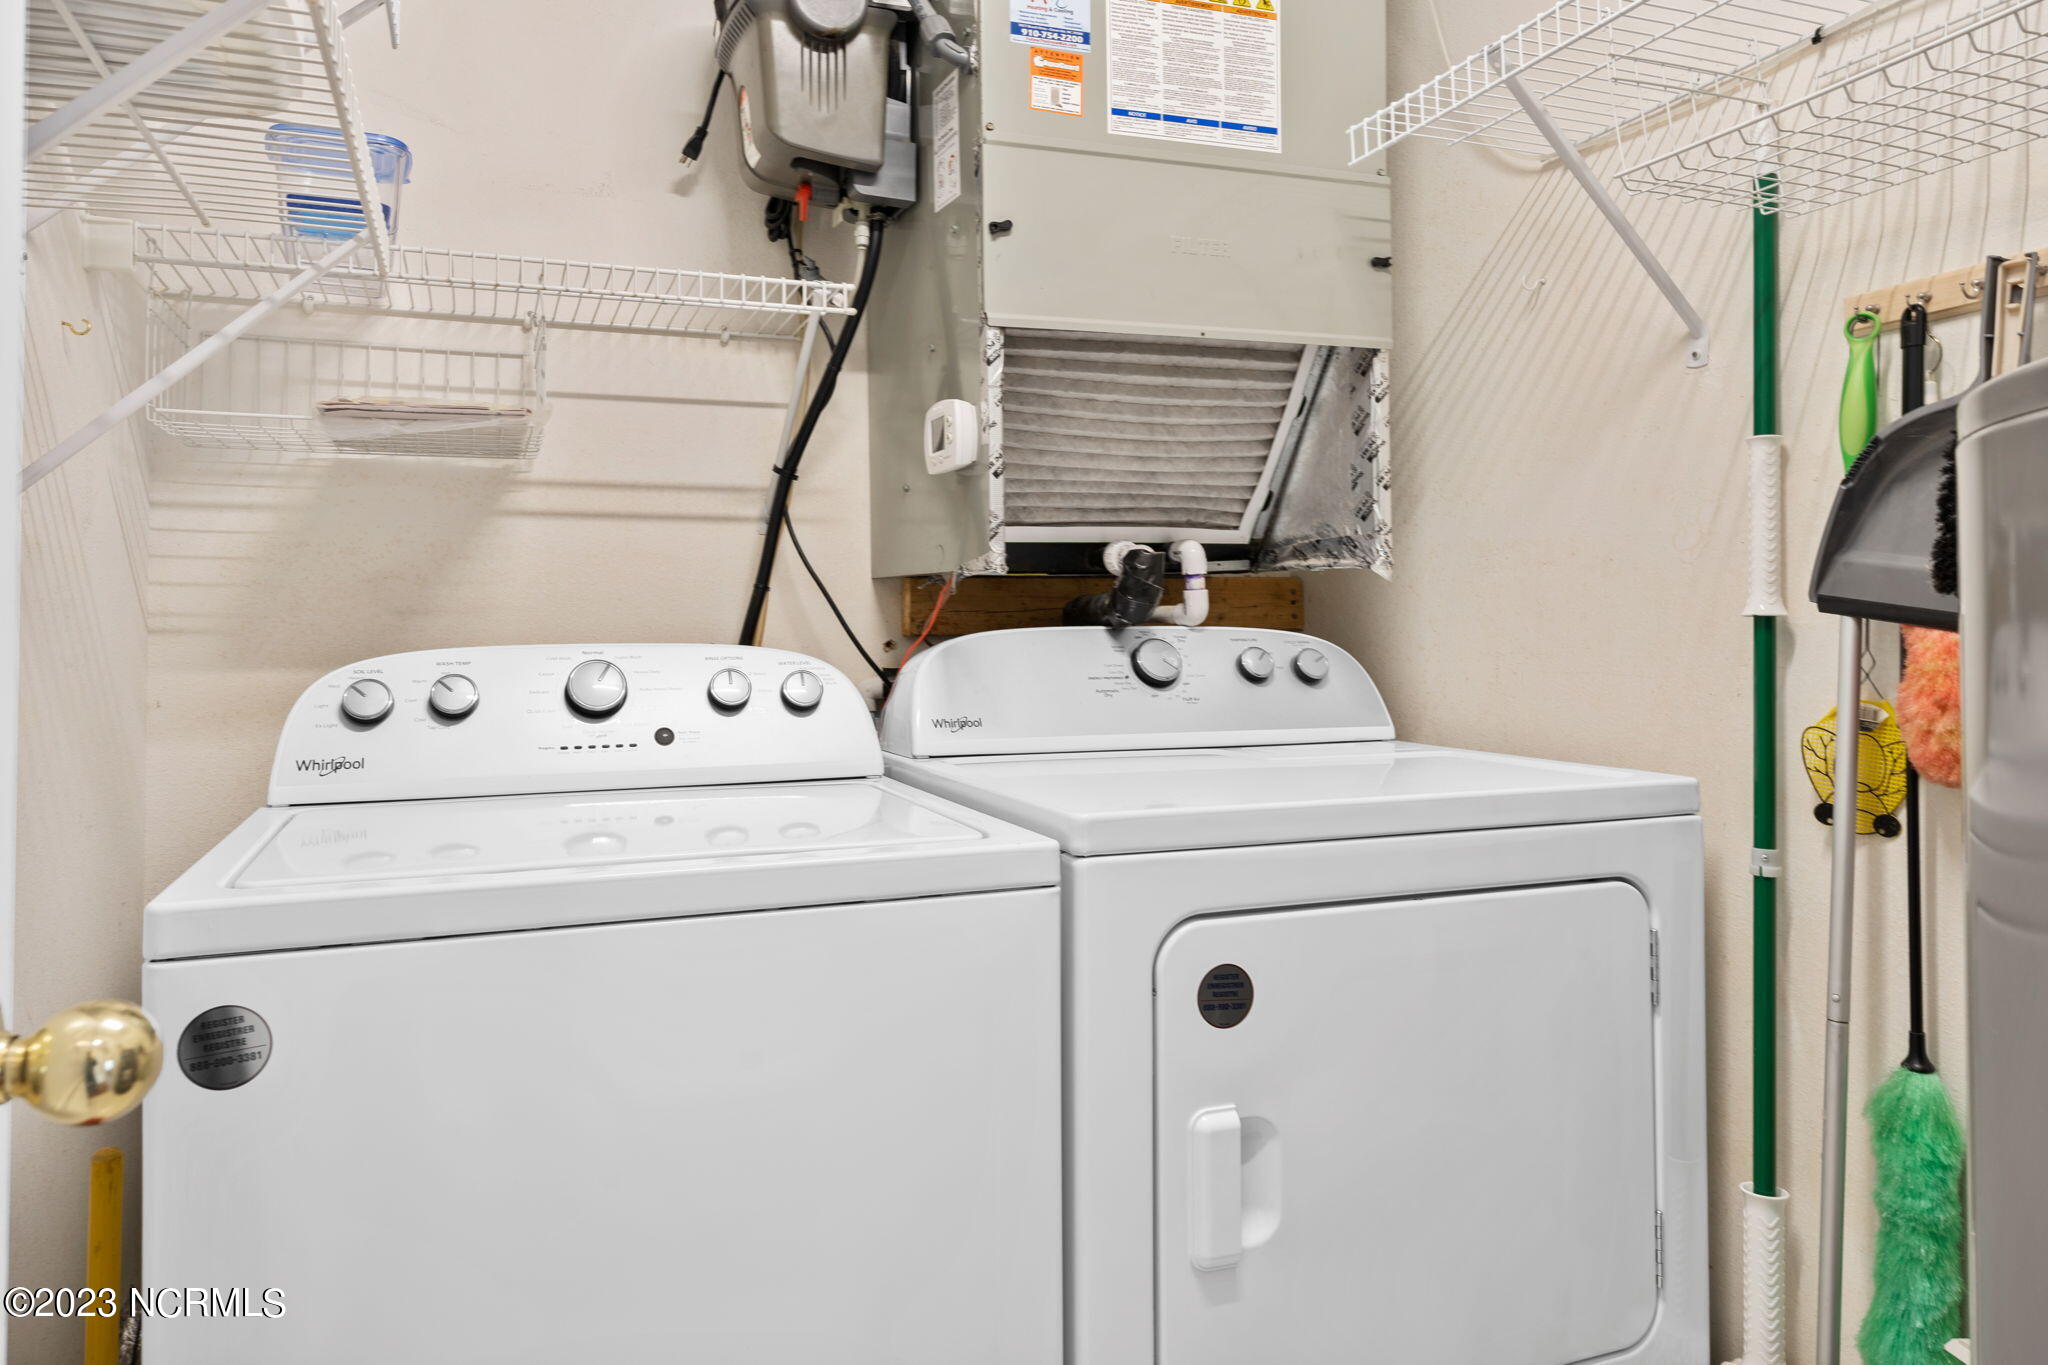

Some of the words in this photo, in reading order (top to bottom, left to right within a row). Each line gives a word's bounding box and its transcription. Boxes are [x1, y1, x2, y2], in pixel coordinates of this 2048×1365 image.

[1020, 28, 1084, 43] 910-754-2200
[931, 716, 983, 733] Whirlpool
[296, 757, 365, 776] Whirlpool
